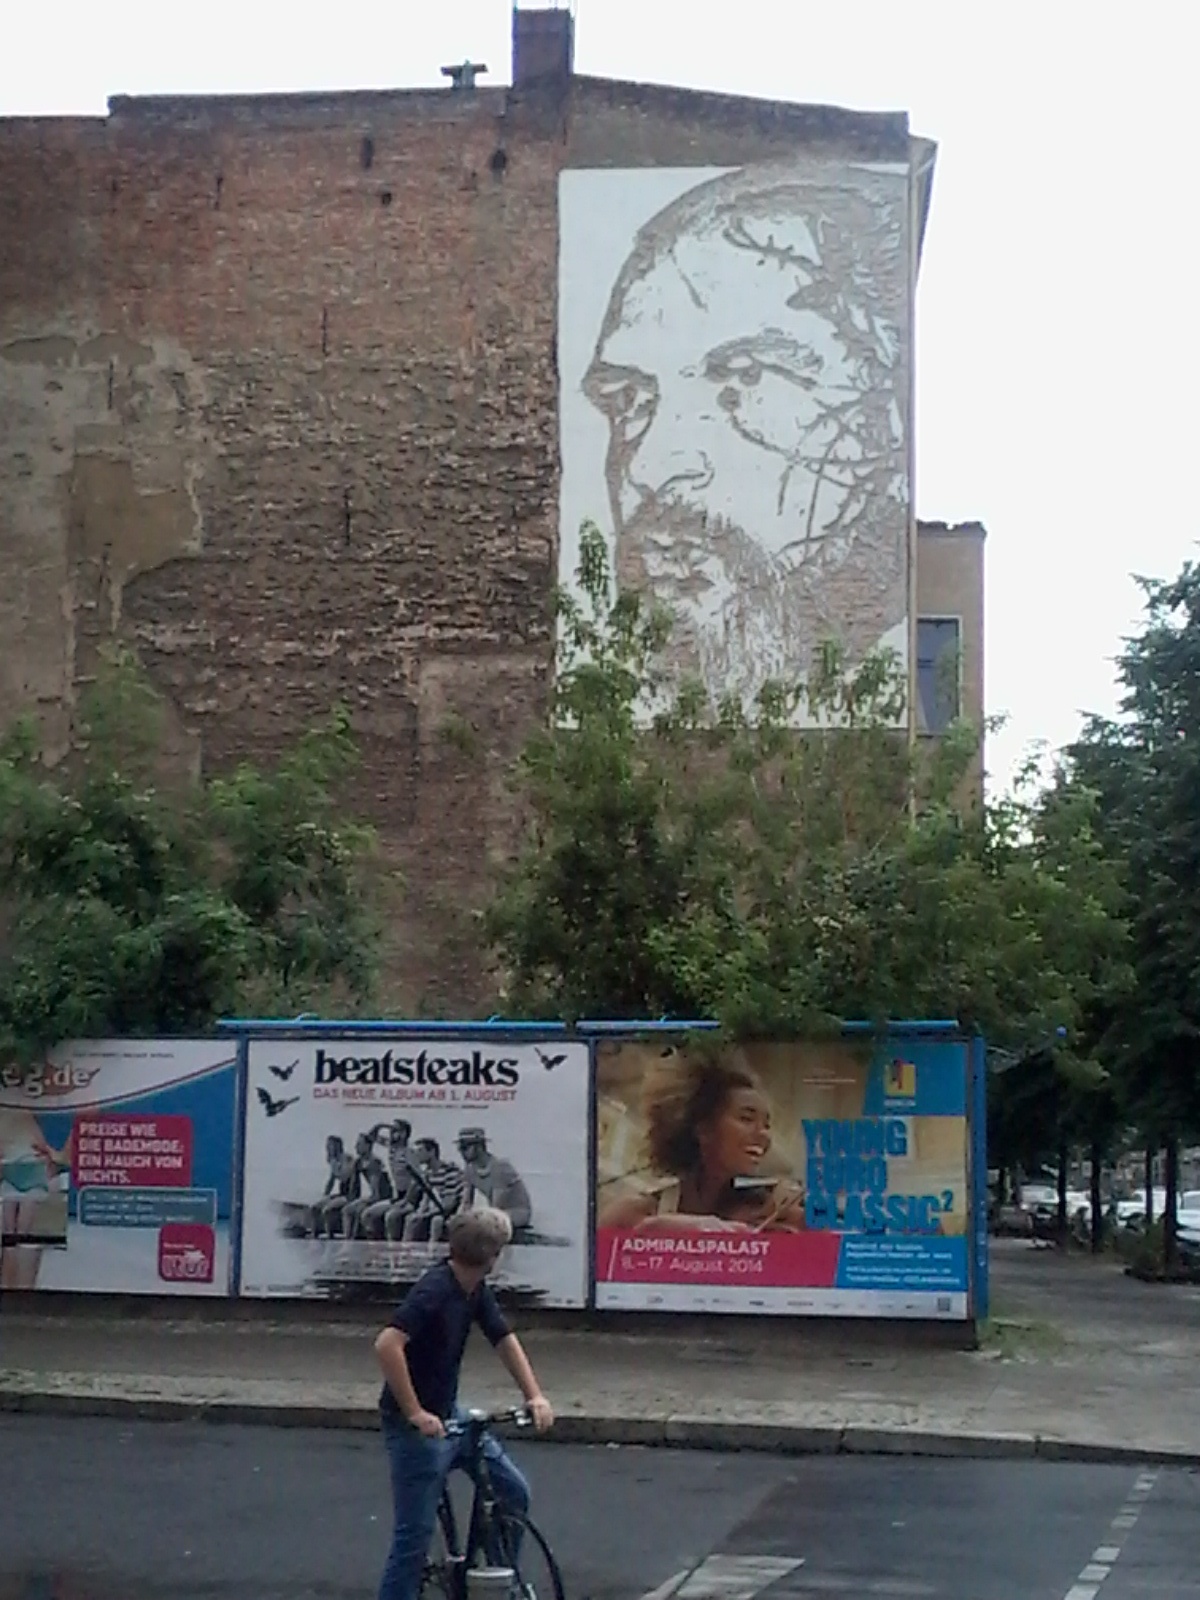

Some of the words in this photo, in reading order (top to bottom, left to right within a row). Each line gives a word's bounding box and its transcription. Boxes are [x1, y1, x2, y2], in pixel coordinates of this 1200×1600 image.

[314, 1049, 519, 1087] beatsteaks
[313, 1087, 339, 1099] DAS
[342, 1087, 376, 1100] NEUE
[380, 1087, 425, 1100] ALBUM
[428, 1087, 446, 1101] AB
[464, 1088, 518, 1101] AUGUST
[621, 1237, 770, 1255] ADMIRALSPALAST
[669, 1257, 723, 1274] August
[728, 1259, 763, 1273] 2014
